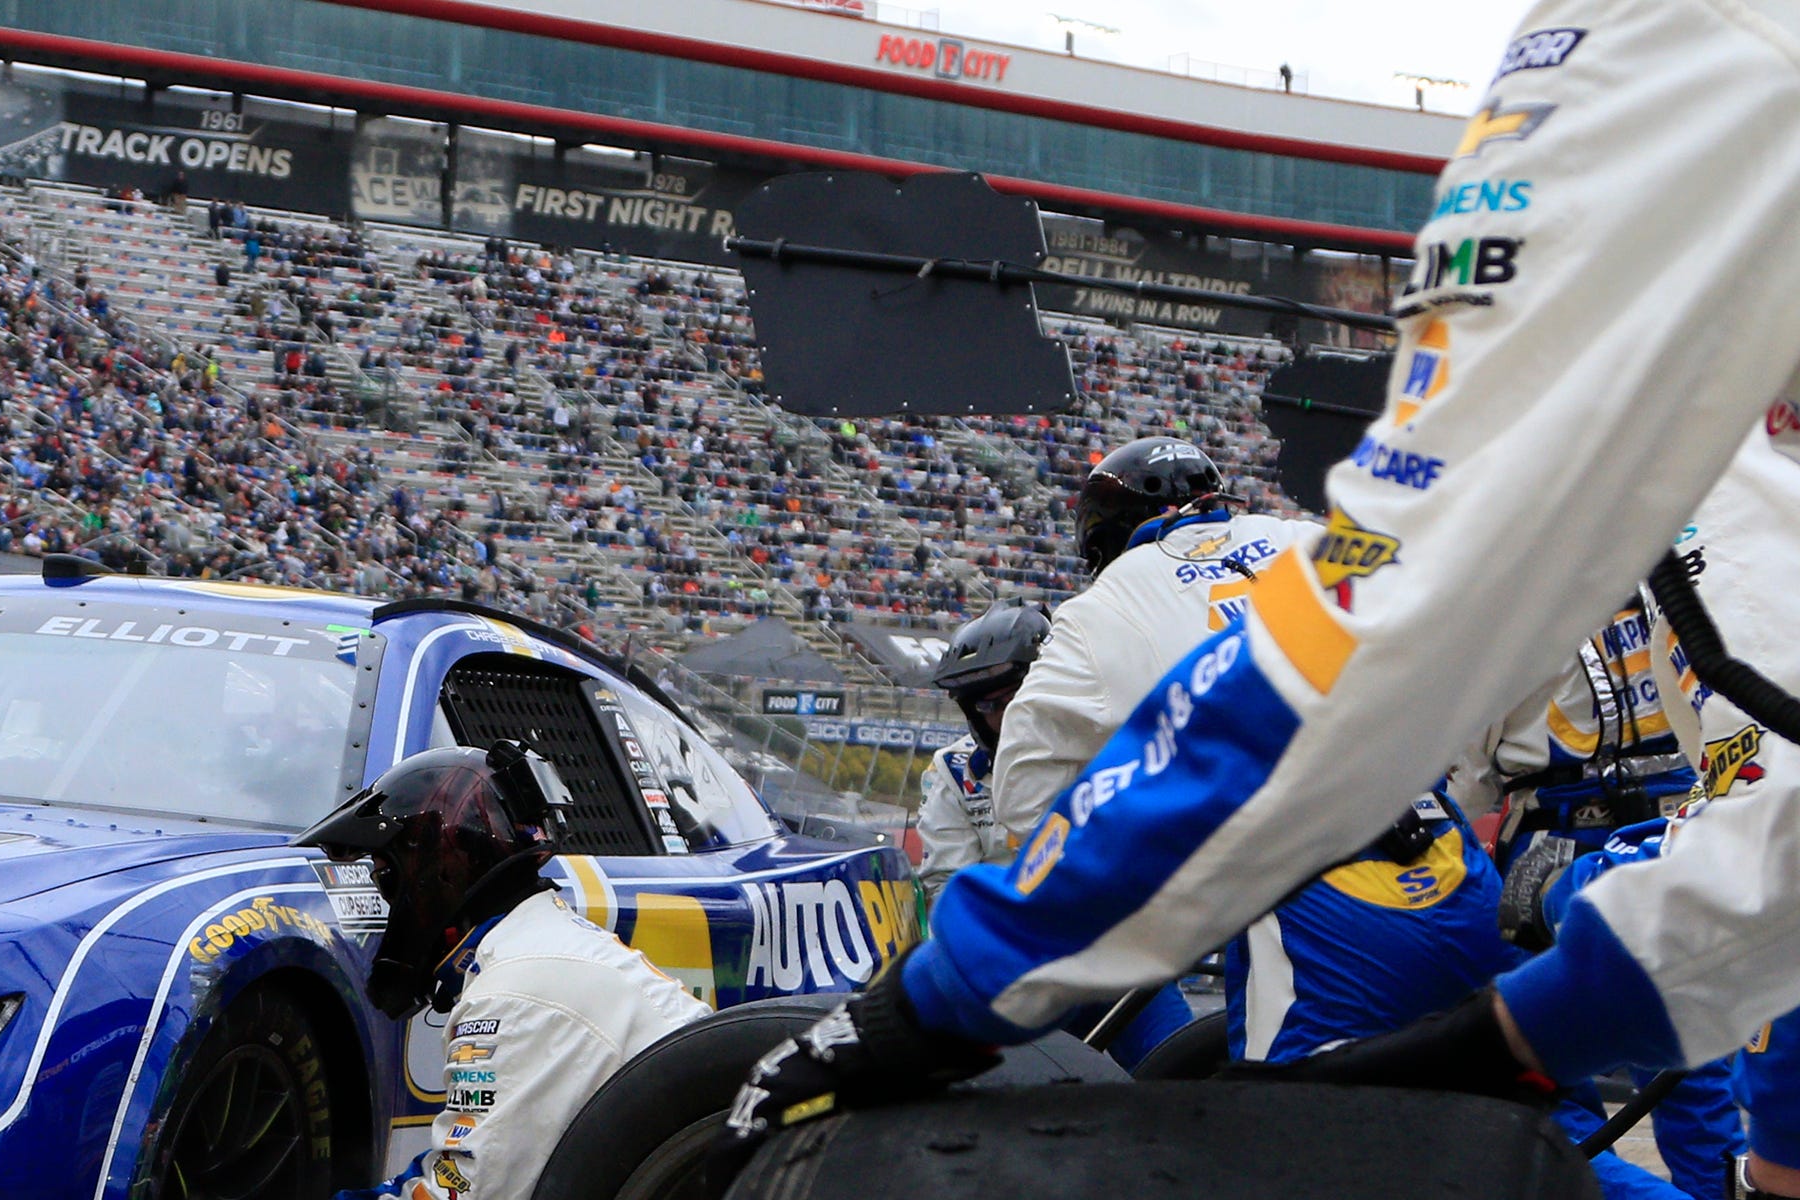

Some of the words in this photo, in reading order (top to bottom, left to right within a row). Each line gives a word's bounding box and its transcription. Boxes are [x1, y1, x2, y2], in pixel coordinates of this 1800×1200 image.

[876, 33, 937, 70] FOOD
[963, 47, 1012, 82] CITY
[200, 108, 245, 132] 1961
[58, 120, 176, 166] TRACK
[179, 137, 294, 179] OPENS
[645, 171, 687, 194] 1978
[514, 183, 604, 223] FIRST
[607, 196, 707, 234] NIGHT
[709, 208, 737, 237] R
[1072, 289, 1088, 307] 7
[1090, 291, 1136, 315] WINS
[1137, 300, 1157, 319] IN
[1158, 305, 1173, 320] A
[1176, 306, 1222, 326] ROW
[35, 615, 310, 656] ELLIOTT
[768, 696, 798, 709] FOOD
[815, 697, 840, 710] CITY
[856, 725, 914, 744] GEICO
[1071, 759, 1140, 828] GET
[335, 864, 371, 885] NASCAR
[355, 895, 383, 916] SERIES
[188, 896, 337, 964] GOODYEAR
[741, 878, 875, 992] AUTO
[456, 1018, 498, 1034] NASCAR
